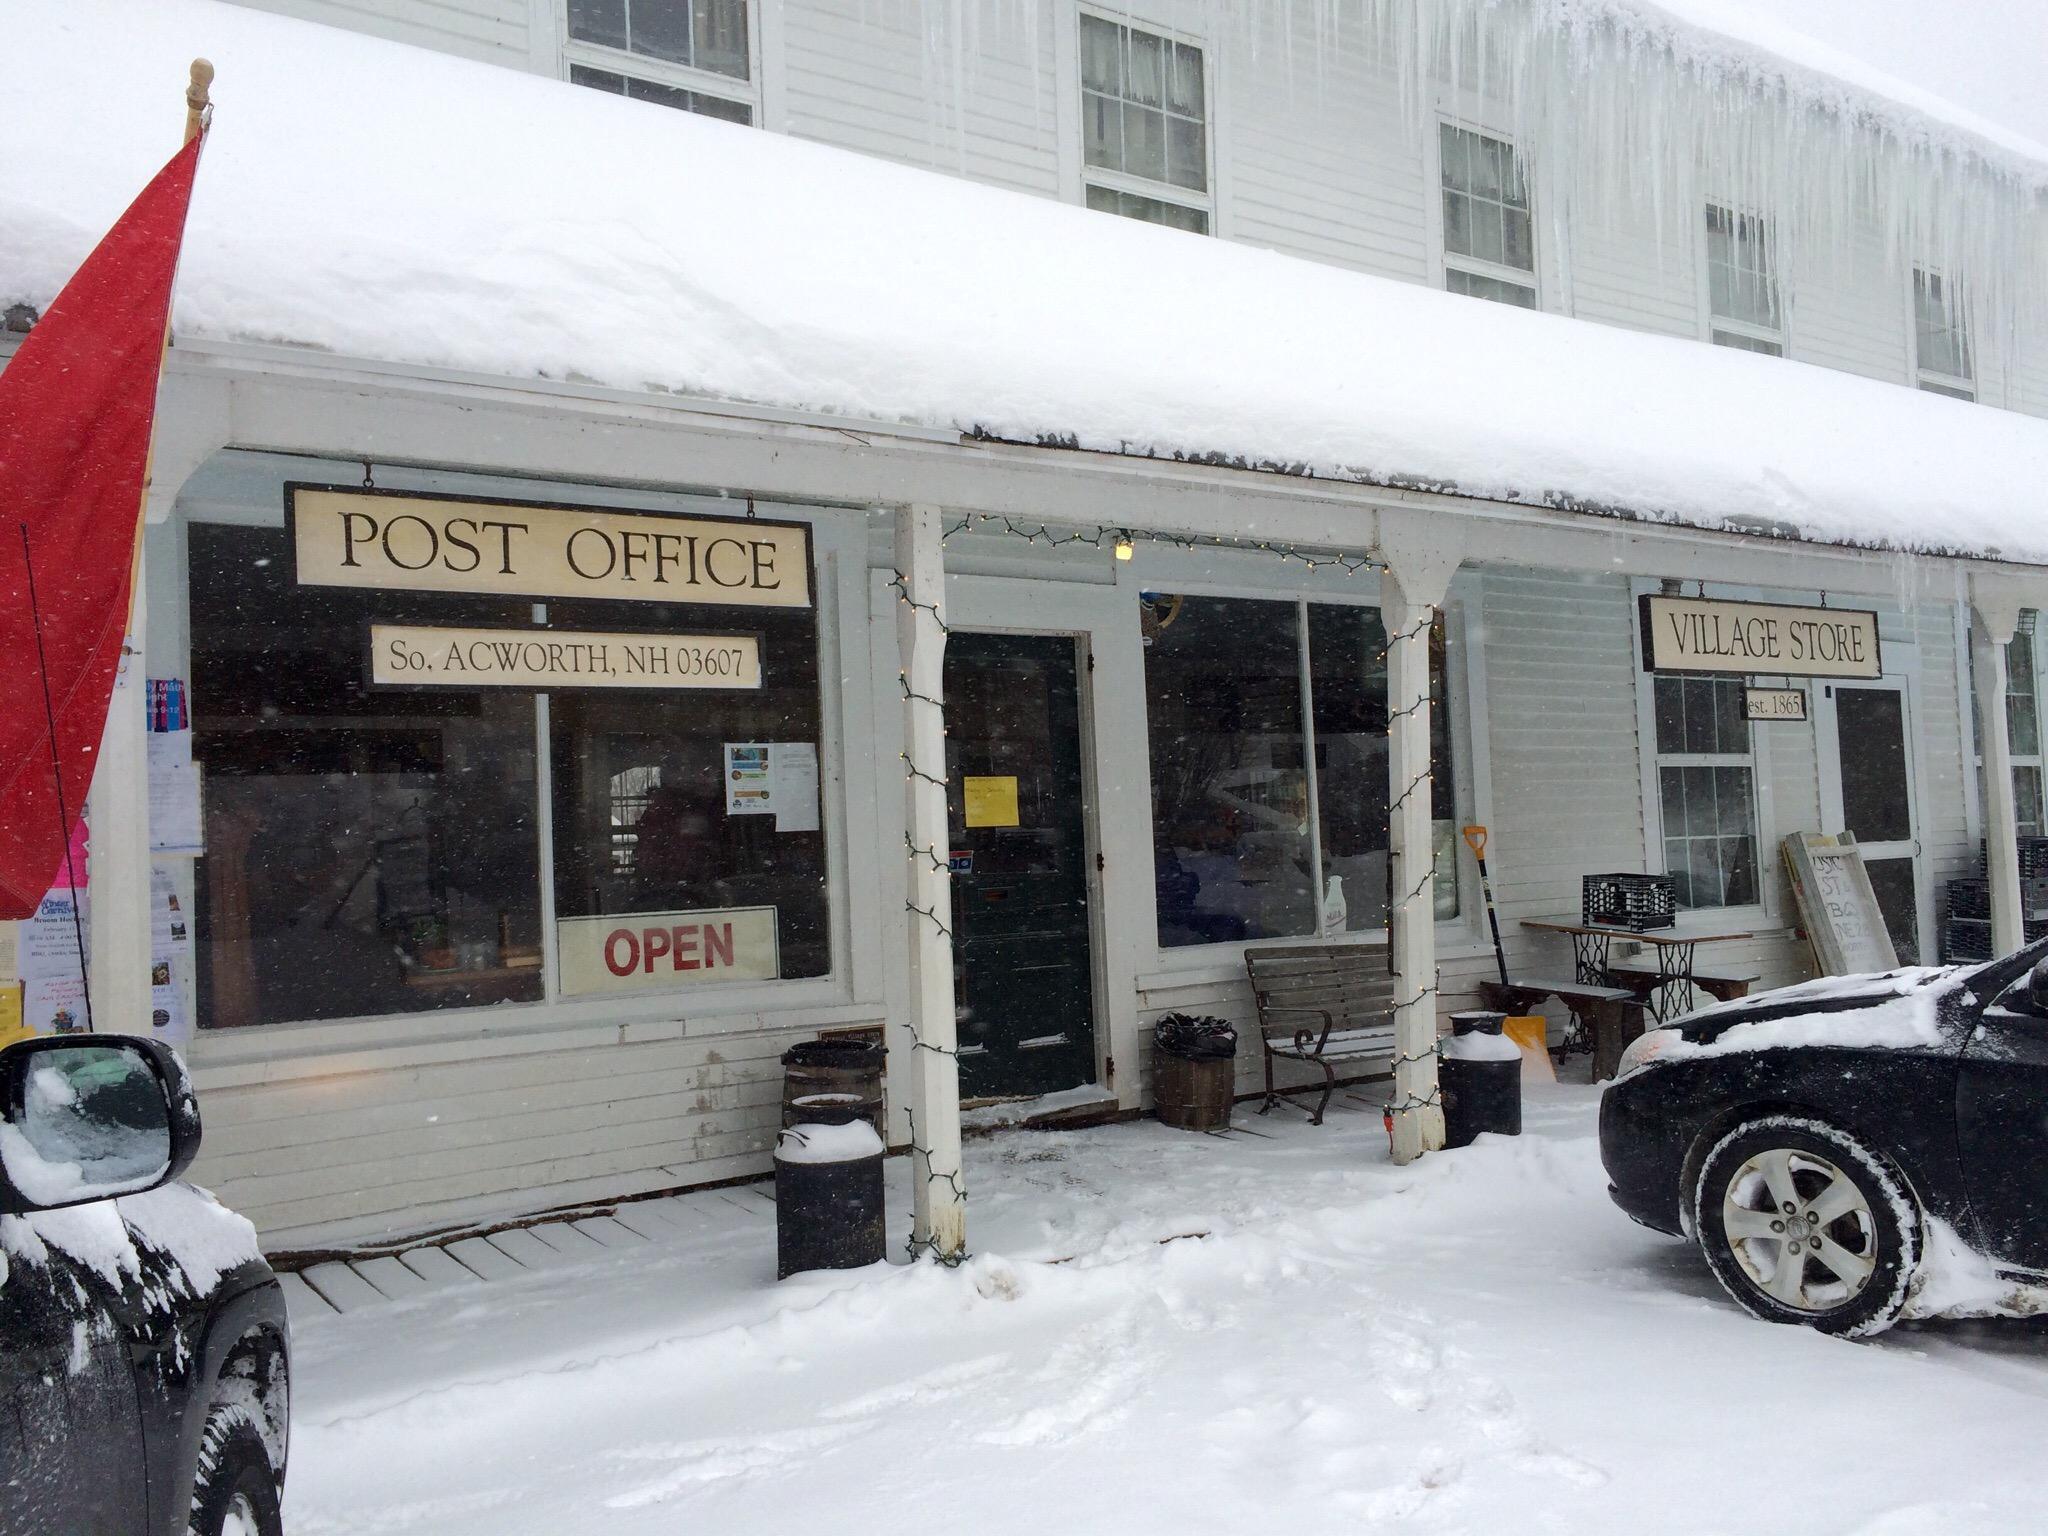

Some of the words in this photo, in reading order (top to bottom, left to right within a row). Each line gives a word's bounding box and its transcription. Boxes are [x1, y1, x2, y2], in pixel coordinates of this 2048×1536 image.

[337, 512, 529, 574] POST
[566, 528, 782, 590] OFFICE
[390, 640, 433, 672] So.
[443, 641, 617, 677] ACWORTH,
[625, 646, 670, 675] NH
[677, 649, 744, 677] 03607
[1668, 613, 1781, 659] VILLAGE
[1789, 620, 1865, 662] STORE
[1748, 698, 1768, 714] est.
[1772, 694, 1800, 714] 1865
[41, 906, 77, 915] Carniv
[604, 922, 735, 977] OPEN
